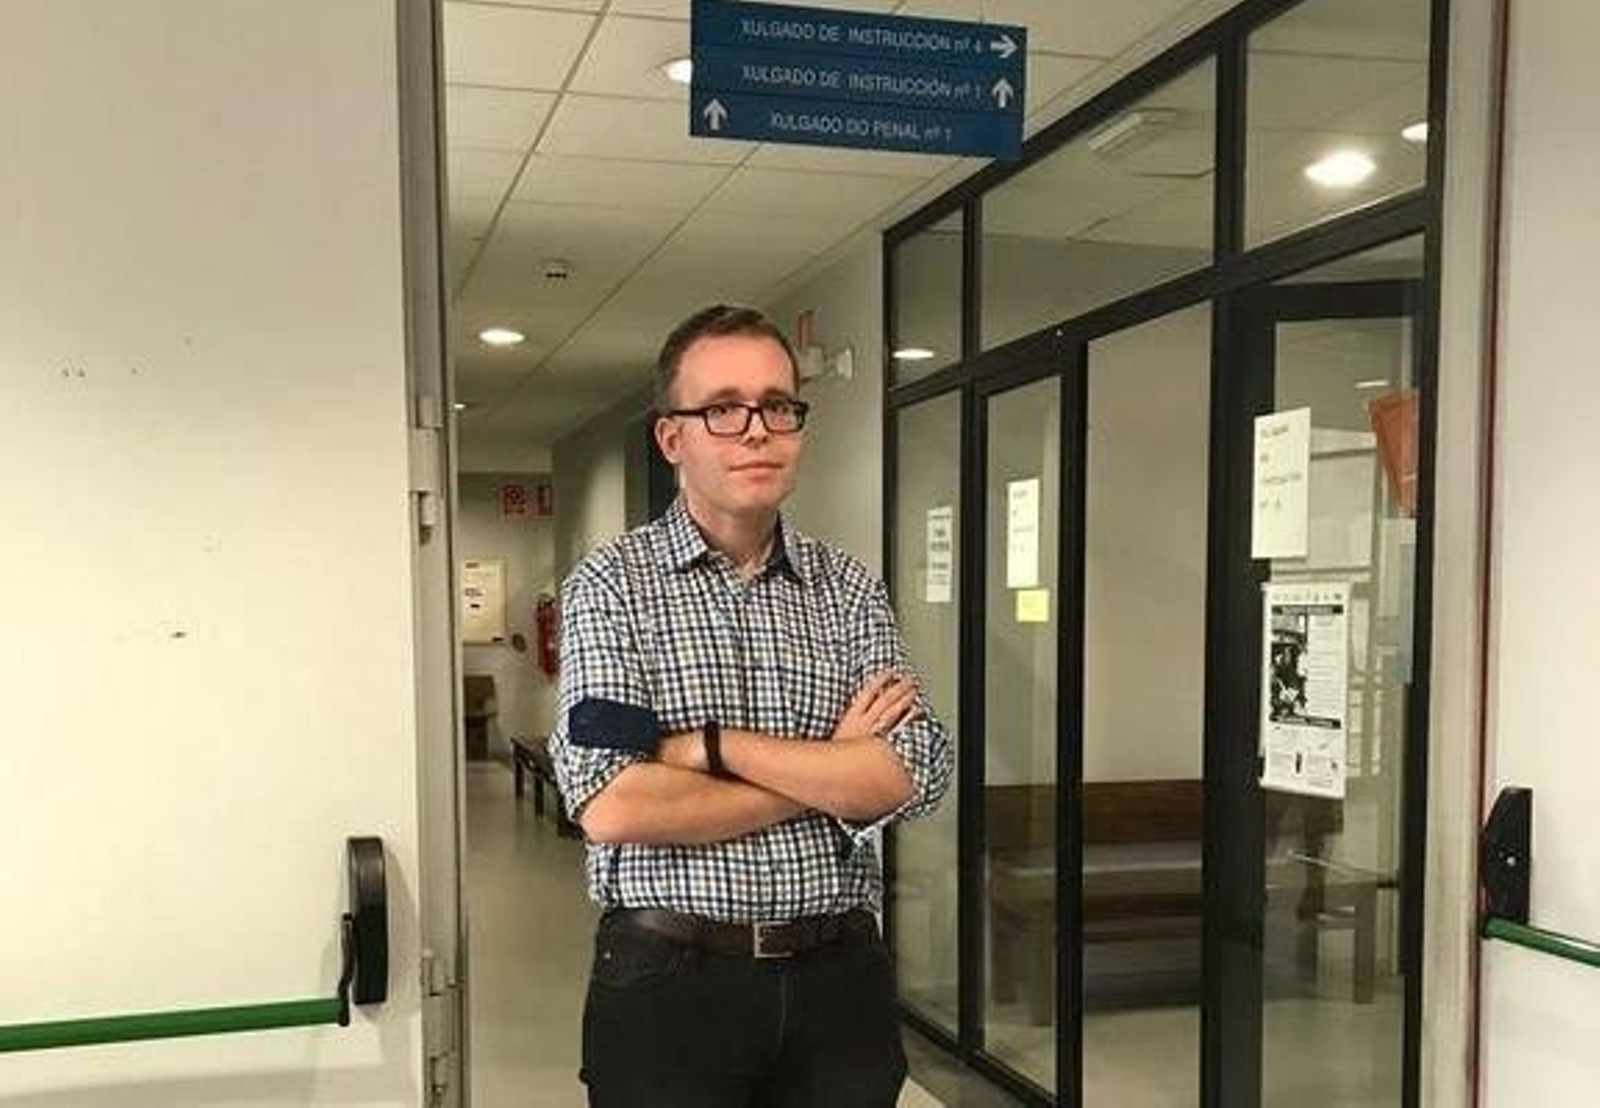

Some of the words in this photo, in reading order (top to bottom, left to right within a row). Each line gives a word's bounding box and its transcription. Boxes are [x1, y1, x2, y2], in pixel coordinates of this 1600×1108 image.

[741, 19, 815, 40] XULGADO
[819, 23, 840, 41] DE
[742, 65, 816, 86] XULGADO
[819, 69, 842, 89] DE
[770, 112, 842, 134] XULGADO
[846, 118, 869, 136] DO
[873, 120, 922, 139] PENAL
